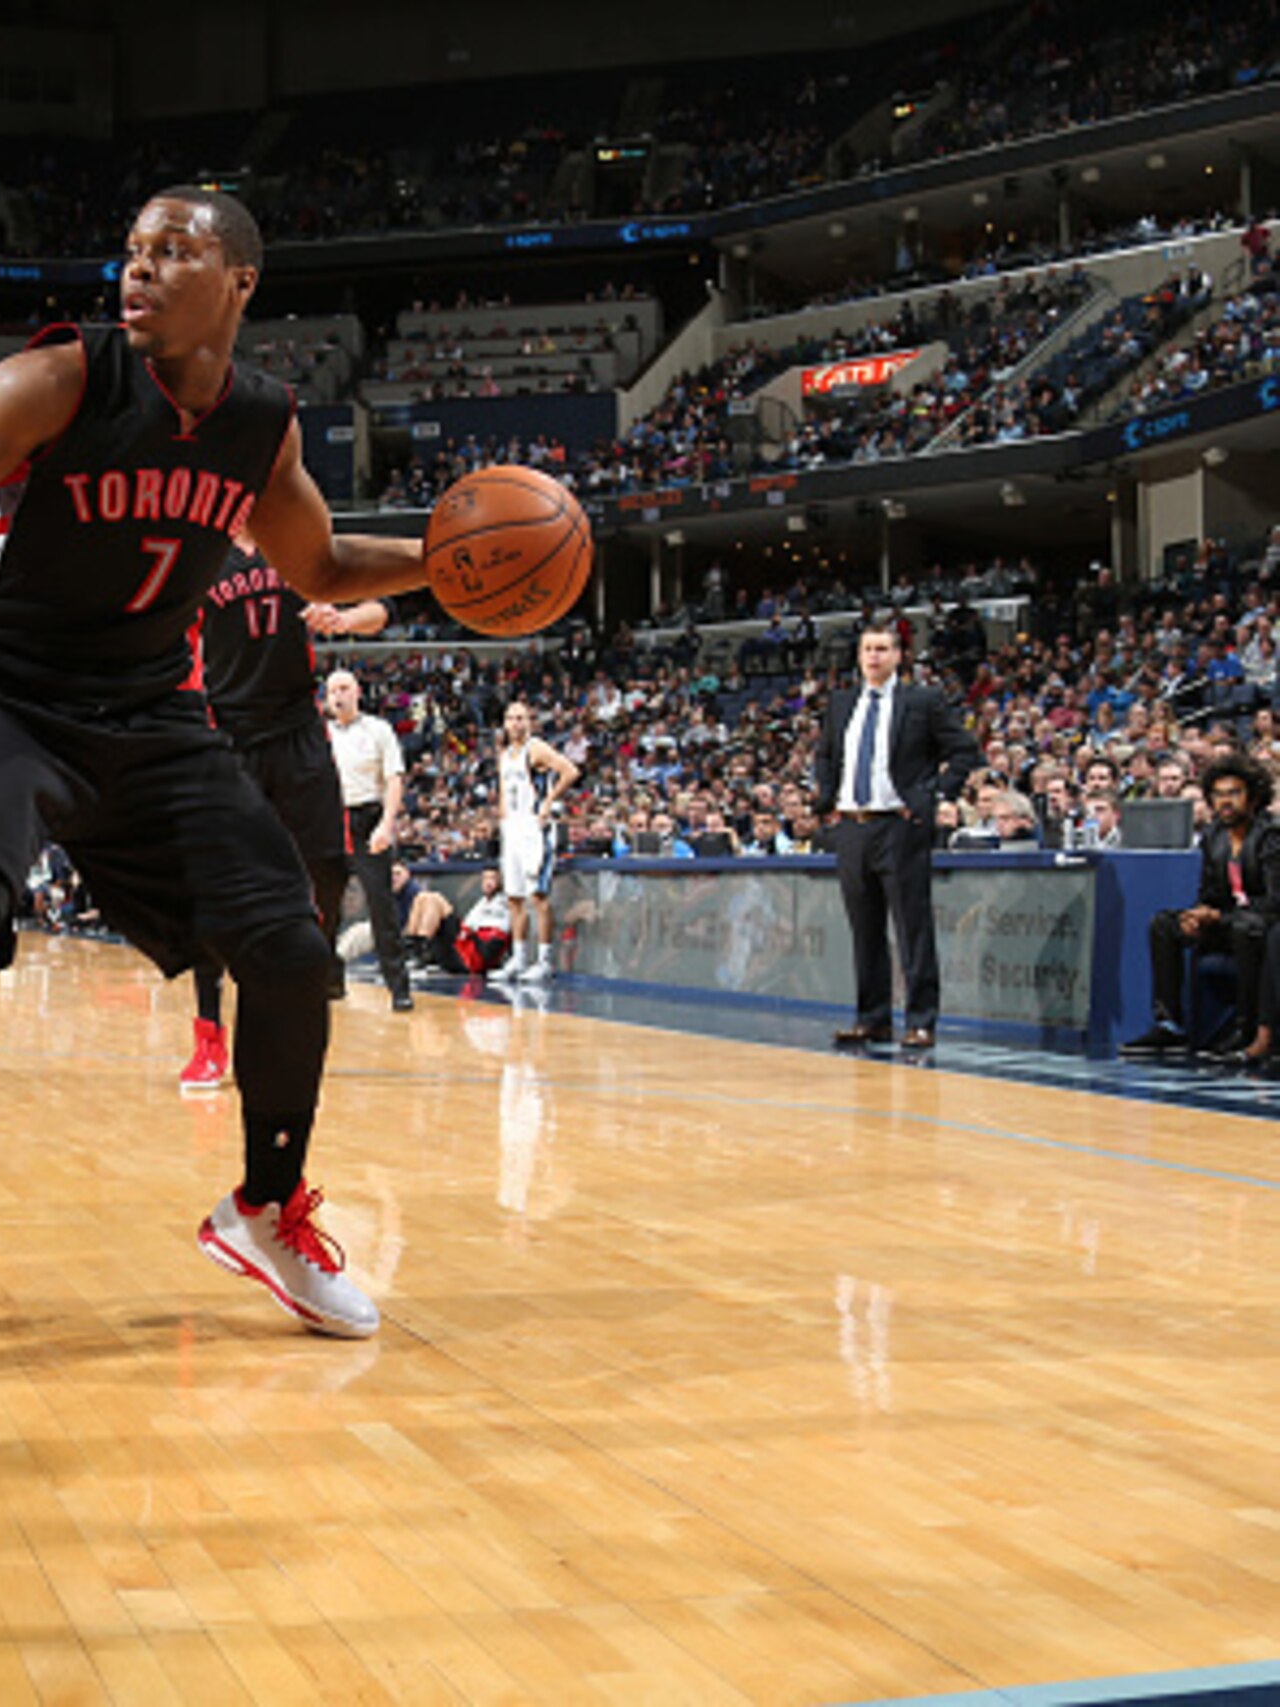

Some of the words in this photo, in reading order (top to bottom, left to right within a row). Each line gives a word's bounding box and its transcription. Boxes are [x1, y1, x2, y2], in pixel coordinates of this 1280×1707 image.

[63, 466, 256, 540] TORONTO
[123, 536, 182, 613] 7
[207, 567, 289, 608] TORON
[244, 594, 280, 638] 17
